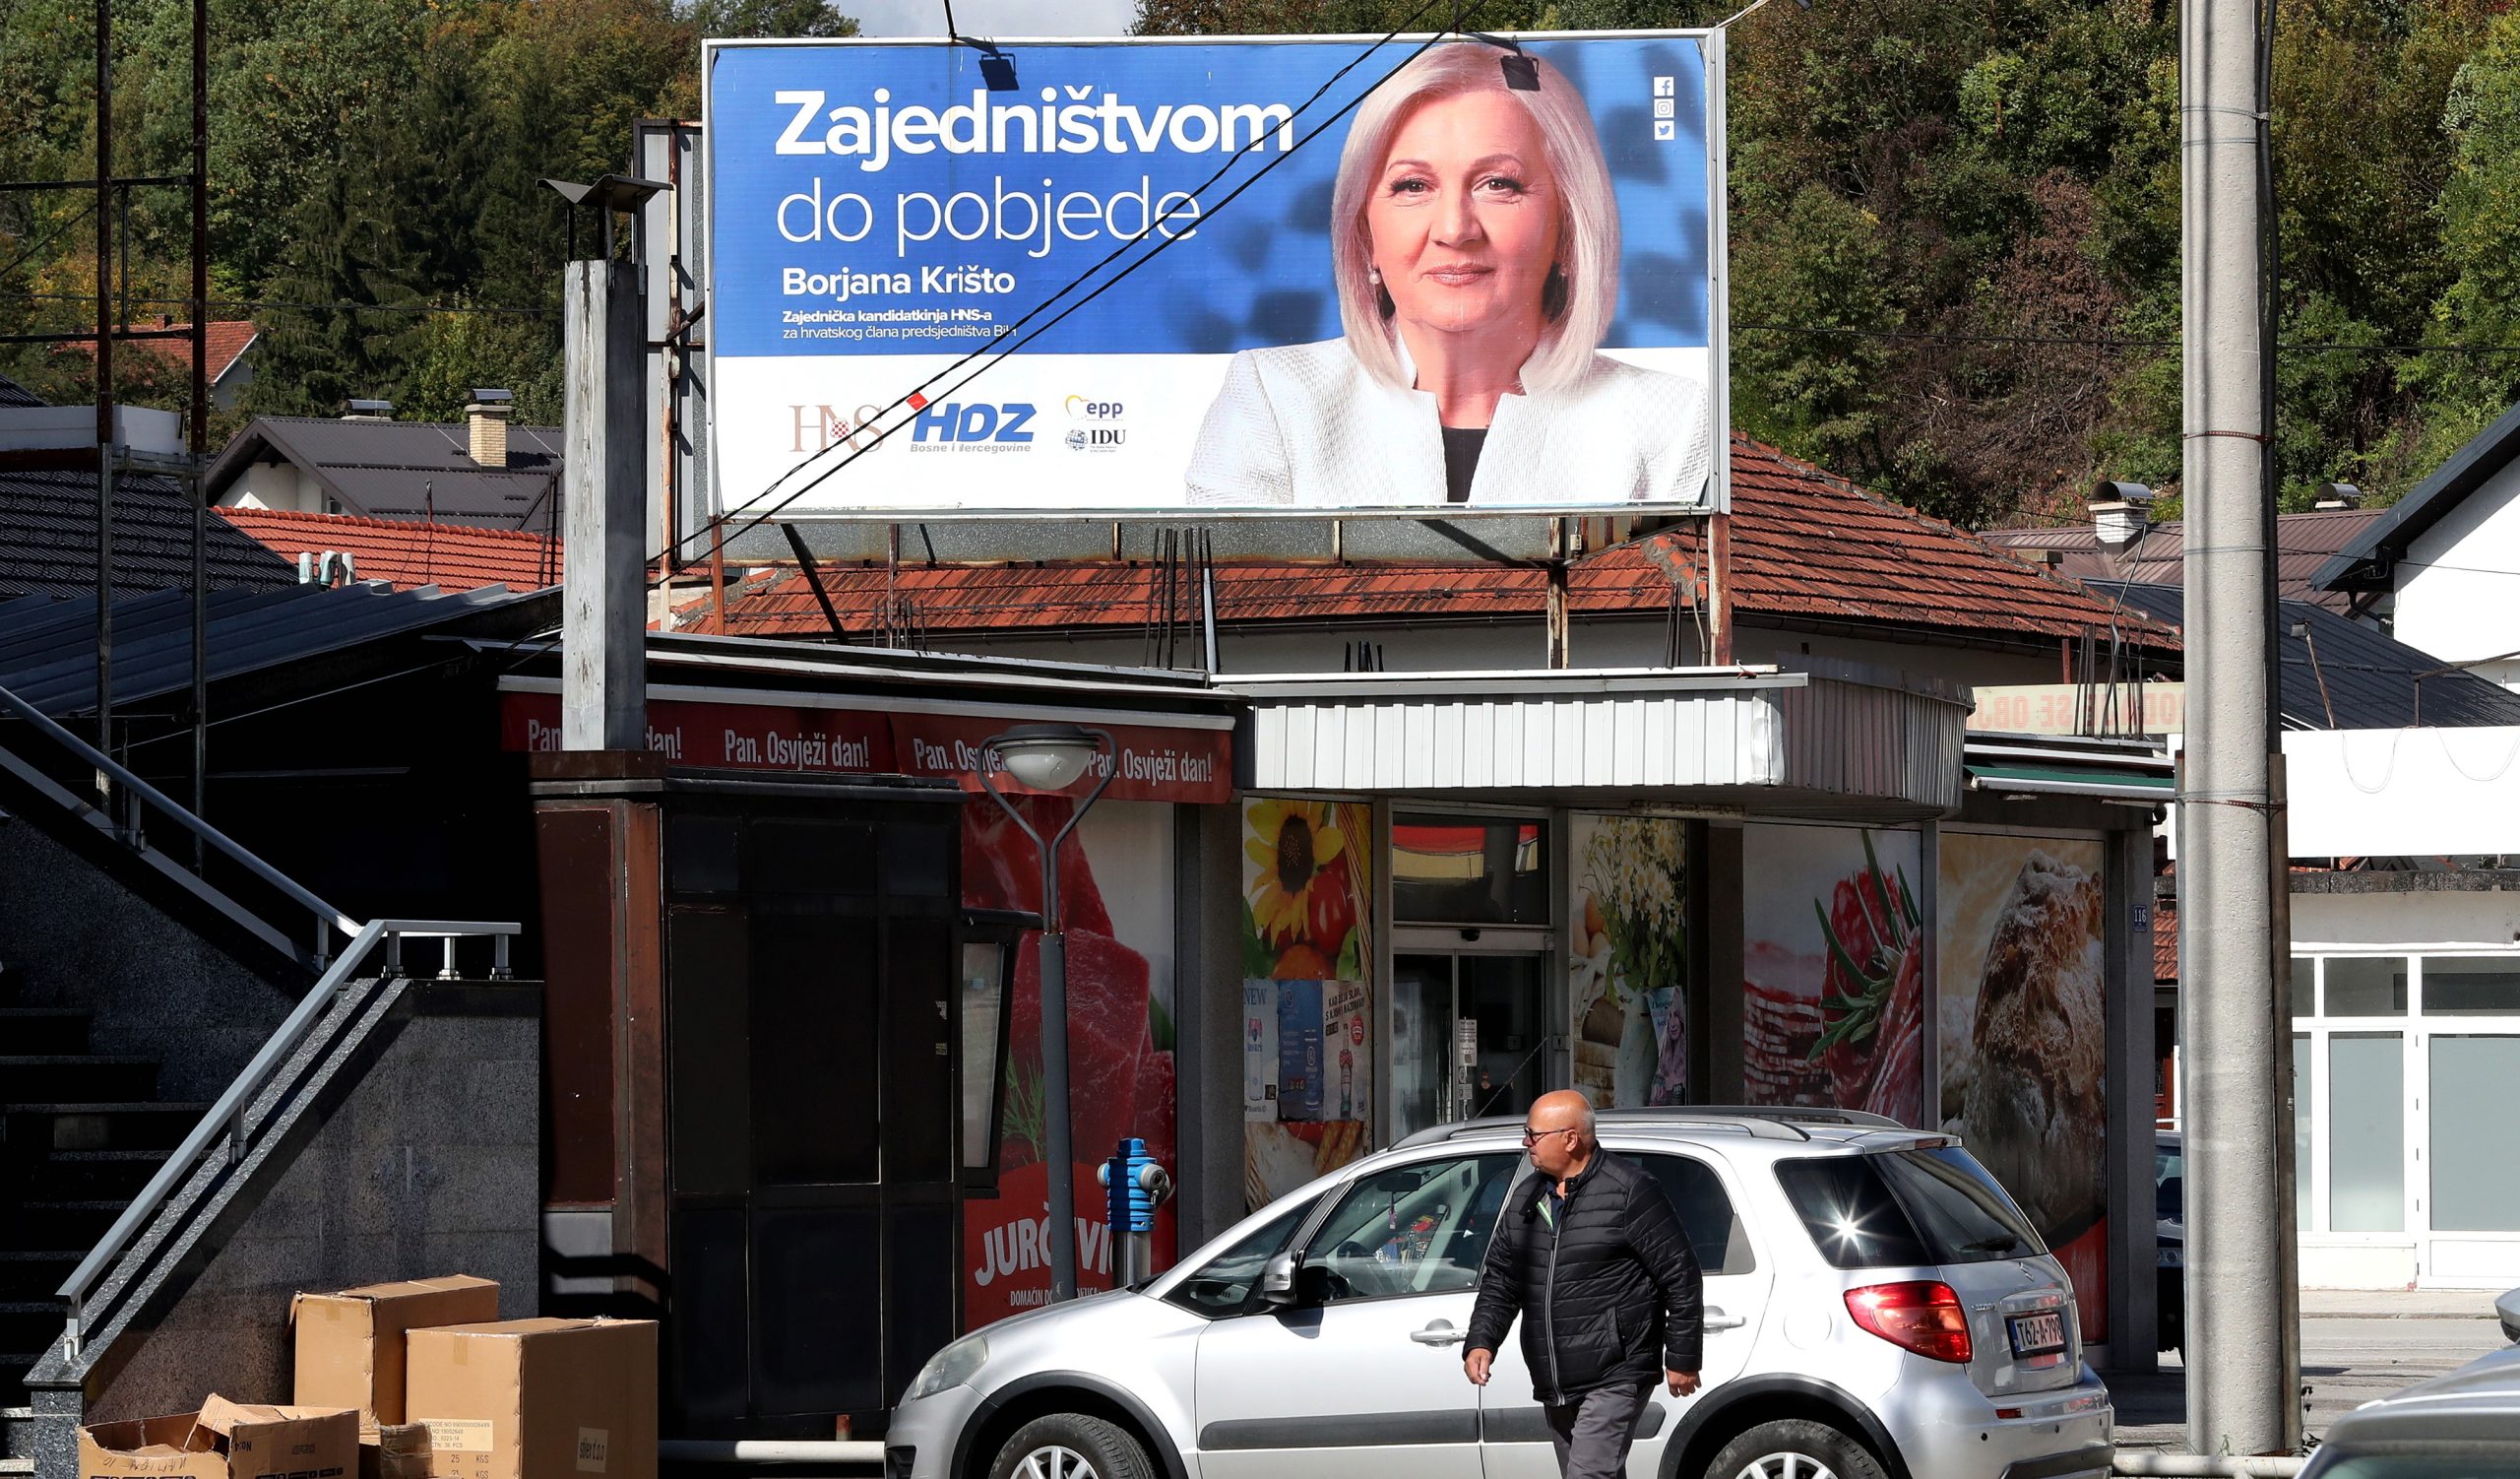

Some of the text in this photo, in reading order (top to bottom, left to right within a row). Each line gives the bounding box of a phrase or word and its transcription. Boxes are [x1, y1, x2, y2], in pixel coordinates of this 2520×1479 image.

[774, 85, 1292, 173] Zajedništvom
[776, 175, 1201, 258] do pobjede
[783, 264, 1016, 301] Borjana Krišto
[783, 309, 992, 325] Zajednička kandidatkinja HNS-a
[783, 327, 797, 339] za
[800, 326, 862, 341] hrvatskog
[865, 325, 899, 338] člana
[902, 325, 991, 340] predsjedništva
[913, 403, 1037, 443] HDZ
[1087, 402, 1123, 418] epp
[788, 404, 884, 453] HNS
[1091, 429, 1126, 444] IDU
[911, 443, 947, 454] Bosne
[951, 443, 956, 453] i
[724, 729, 870, 772] Pan. Osvježi dan!
[913, 738, 954, 770] Pan.
[1123, 747, 1176, 787] Osvježi
[1180, 751, 1213, 782] dan!
[2134, 909, 2147, 923] 116
[1243, 988, 1268, 1005] NEW
[975, 1200, 1113, 1287] JURČVI
[1010, 1287, 1043, 1307] DOMAĆIN
[451, 1453, 489, 1464] 25 KGS
